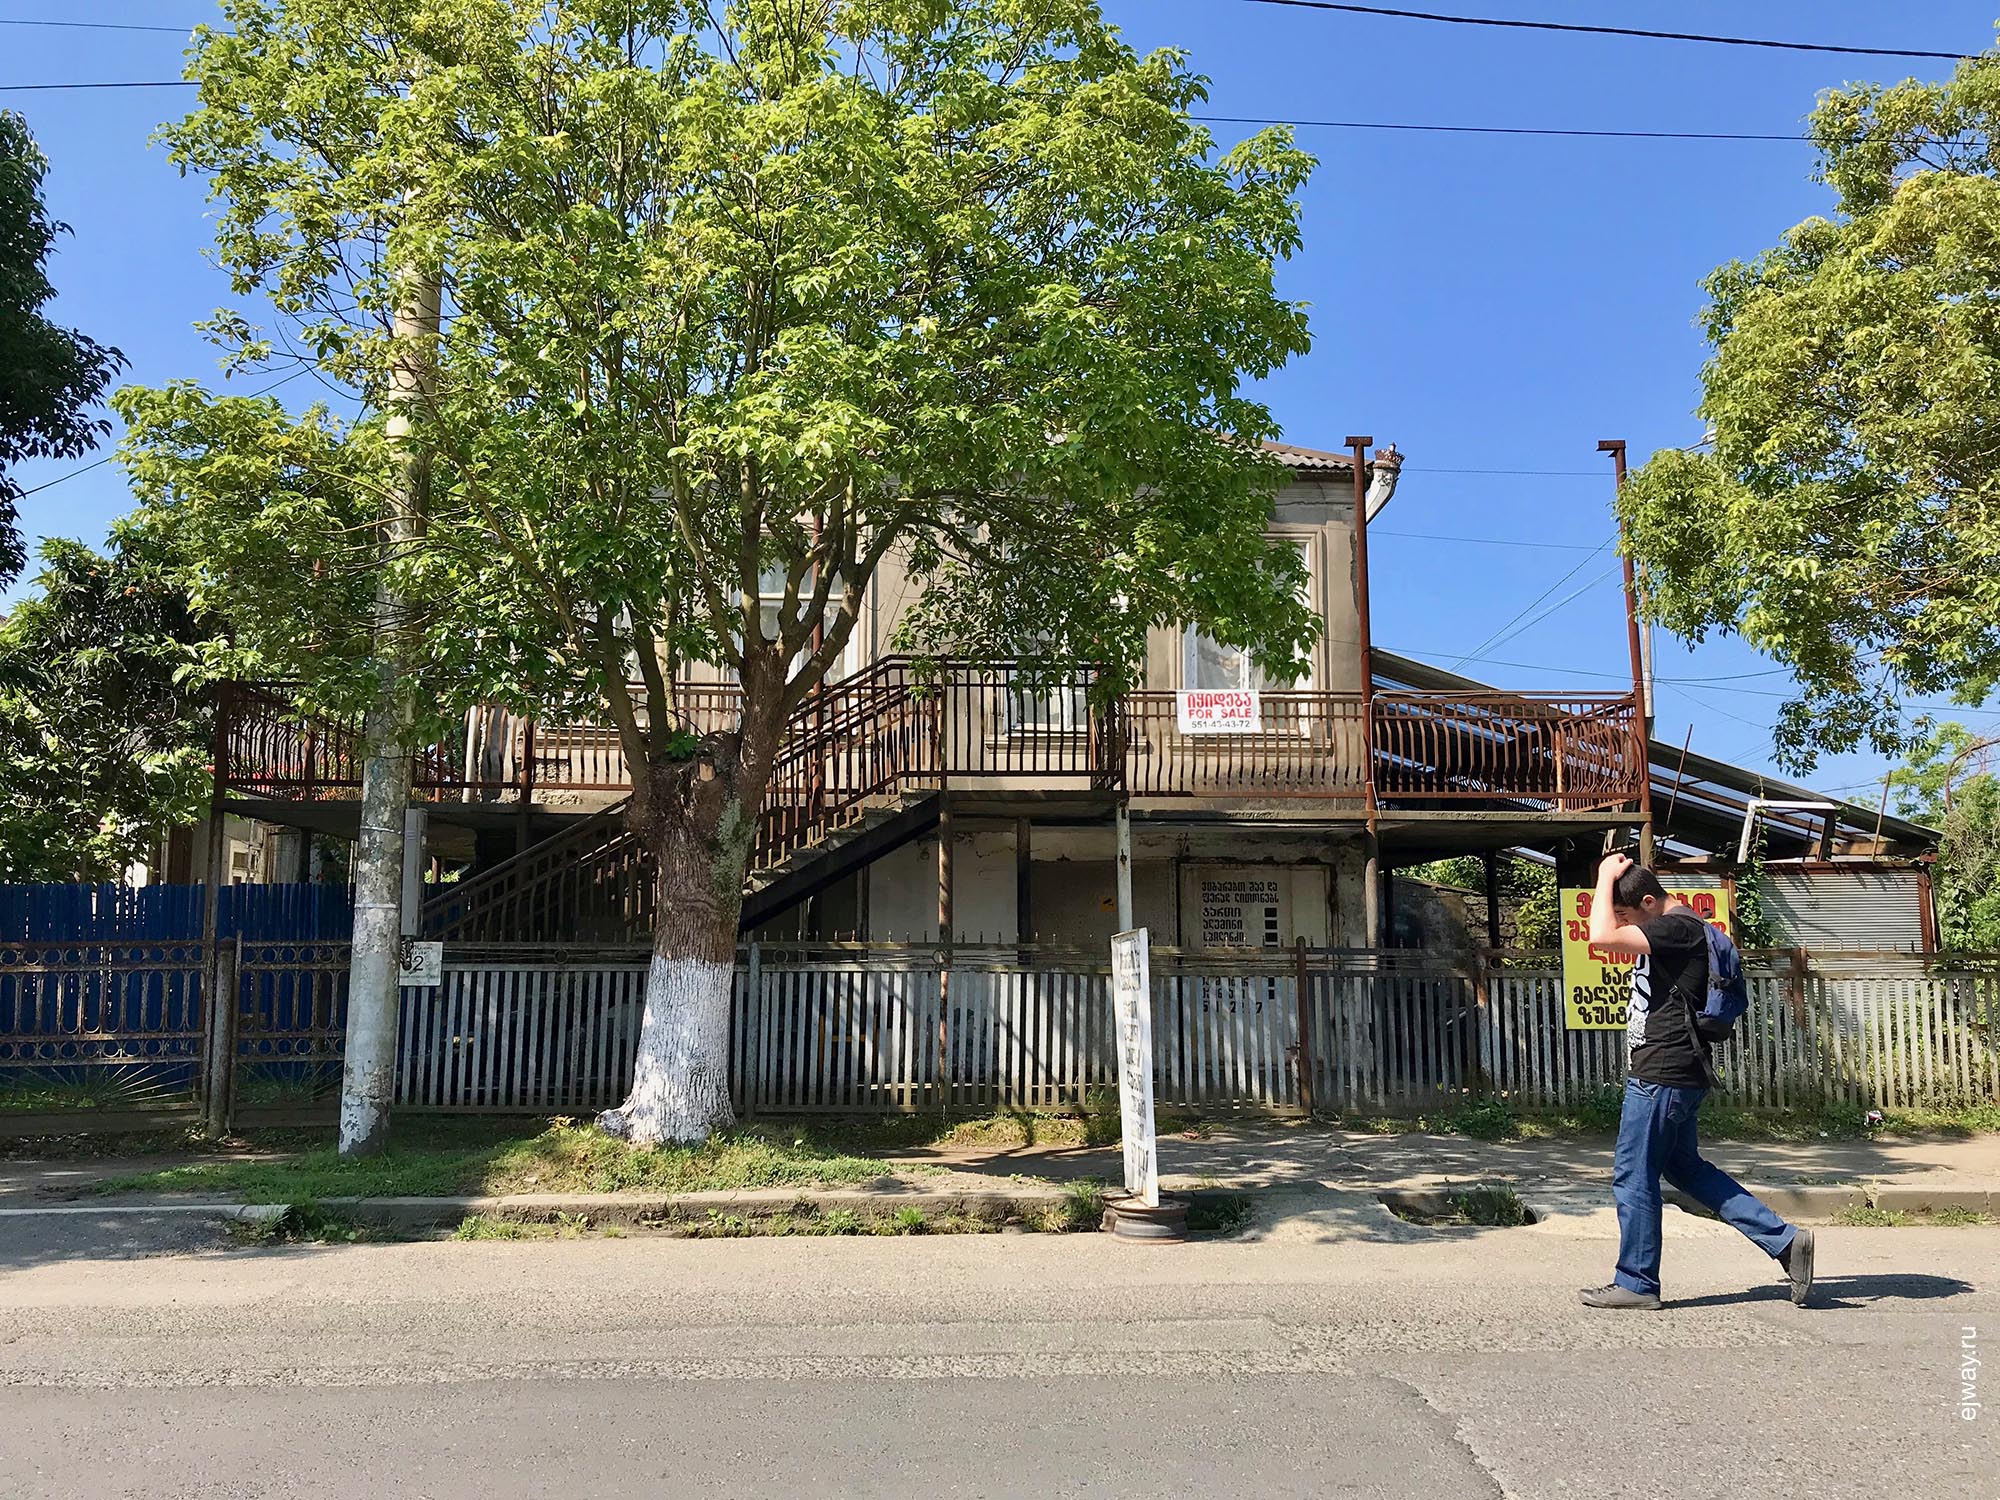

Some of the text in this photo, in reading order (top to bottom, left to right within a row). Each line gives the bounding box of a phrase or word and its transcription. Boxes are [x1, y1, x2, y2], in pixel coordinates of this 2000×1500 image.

[1187, 692, 1252, 708] იყიდება
[1188, 708, 1252, 719] FOR SALE
[1267, 881, 1278, 892] და
